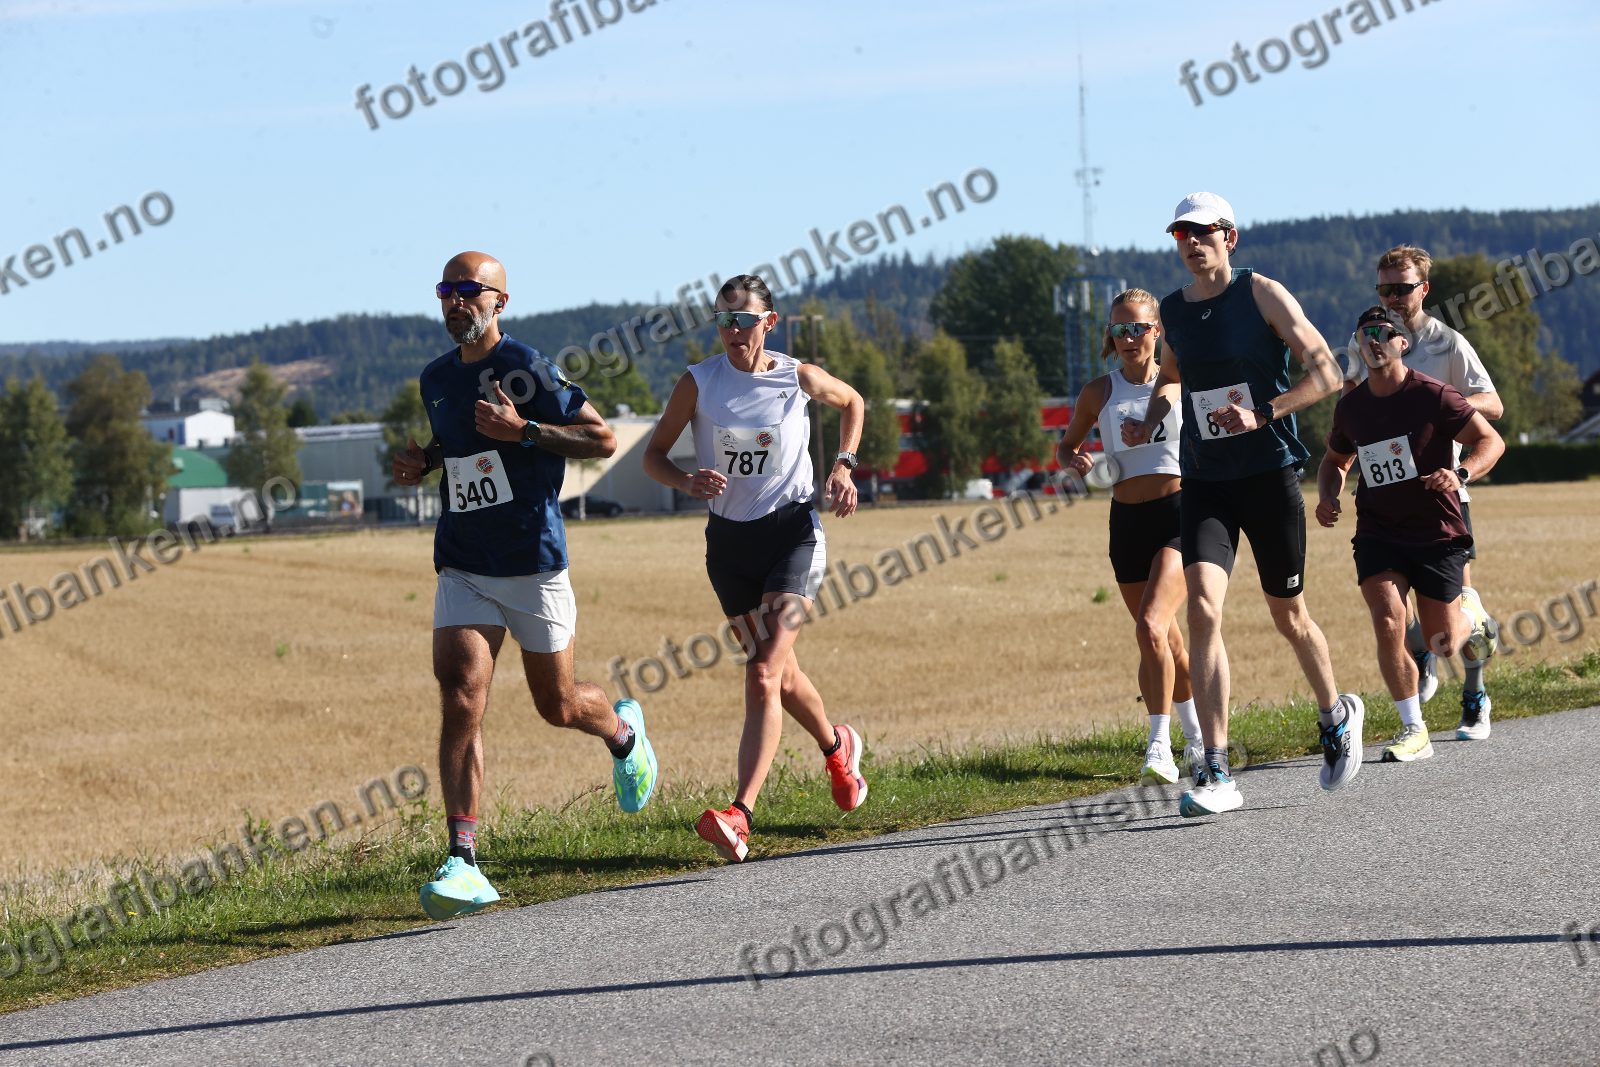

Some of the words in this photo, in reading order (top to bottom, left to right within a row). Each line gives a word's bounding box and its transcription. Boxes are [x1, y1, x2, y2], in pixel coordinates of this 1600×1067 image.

[724, 450, 769, 476] 787
[1370, 458, 1406, 484] 813
[456, 477, 498, 511] 540
